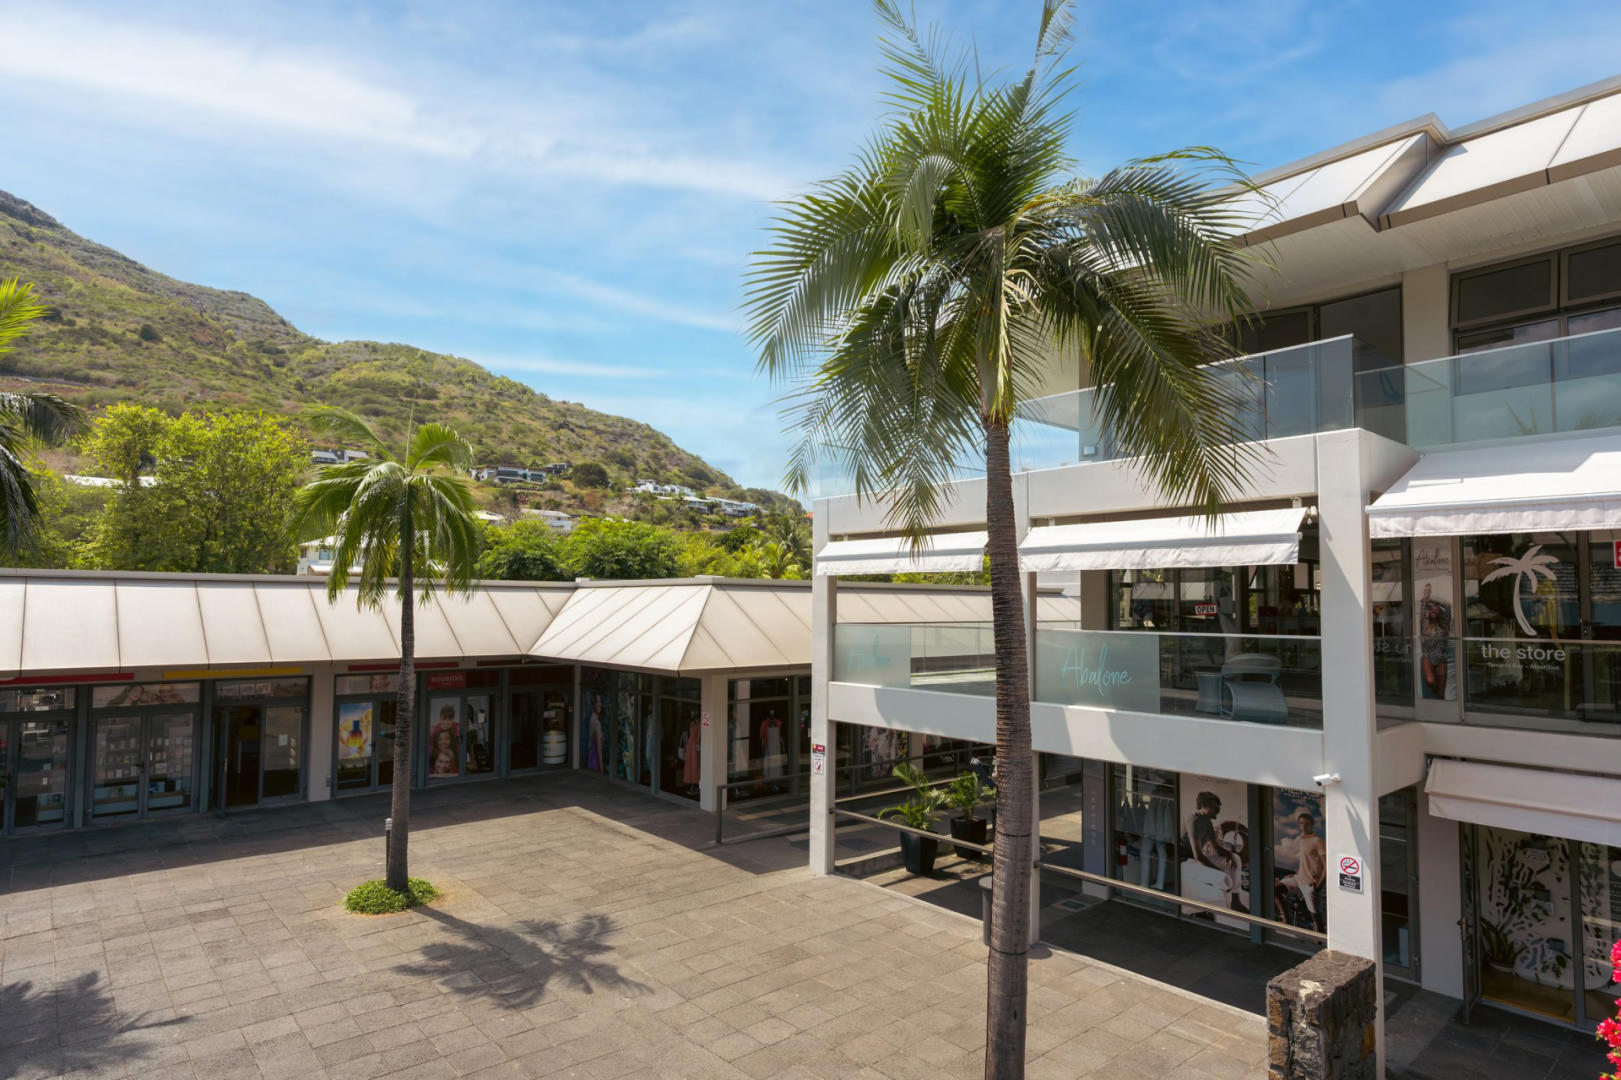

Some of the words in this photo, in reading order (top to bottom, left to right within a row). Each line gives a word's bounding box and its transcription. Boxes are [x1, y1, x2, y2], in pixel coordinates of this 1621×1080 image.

[1197, 606, 1215, 614] OPEN
[1481, 644, 1511, 659] the
[1516, 645, 1566, 661] store
[1058, 644, 1132, 696] Abalone
